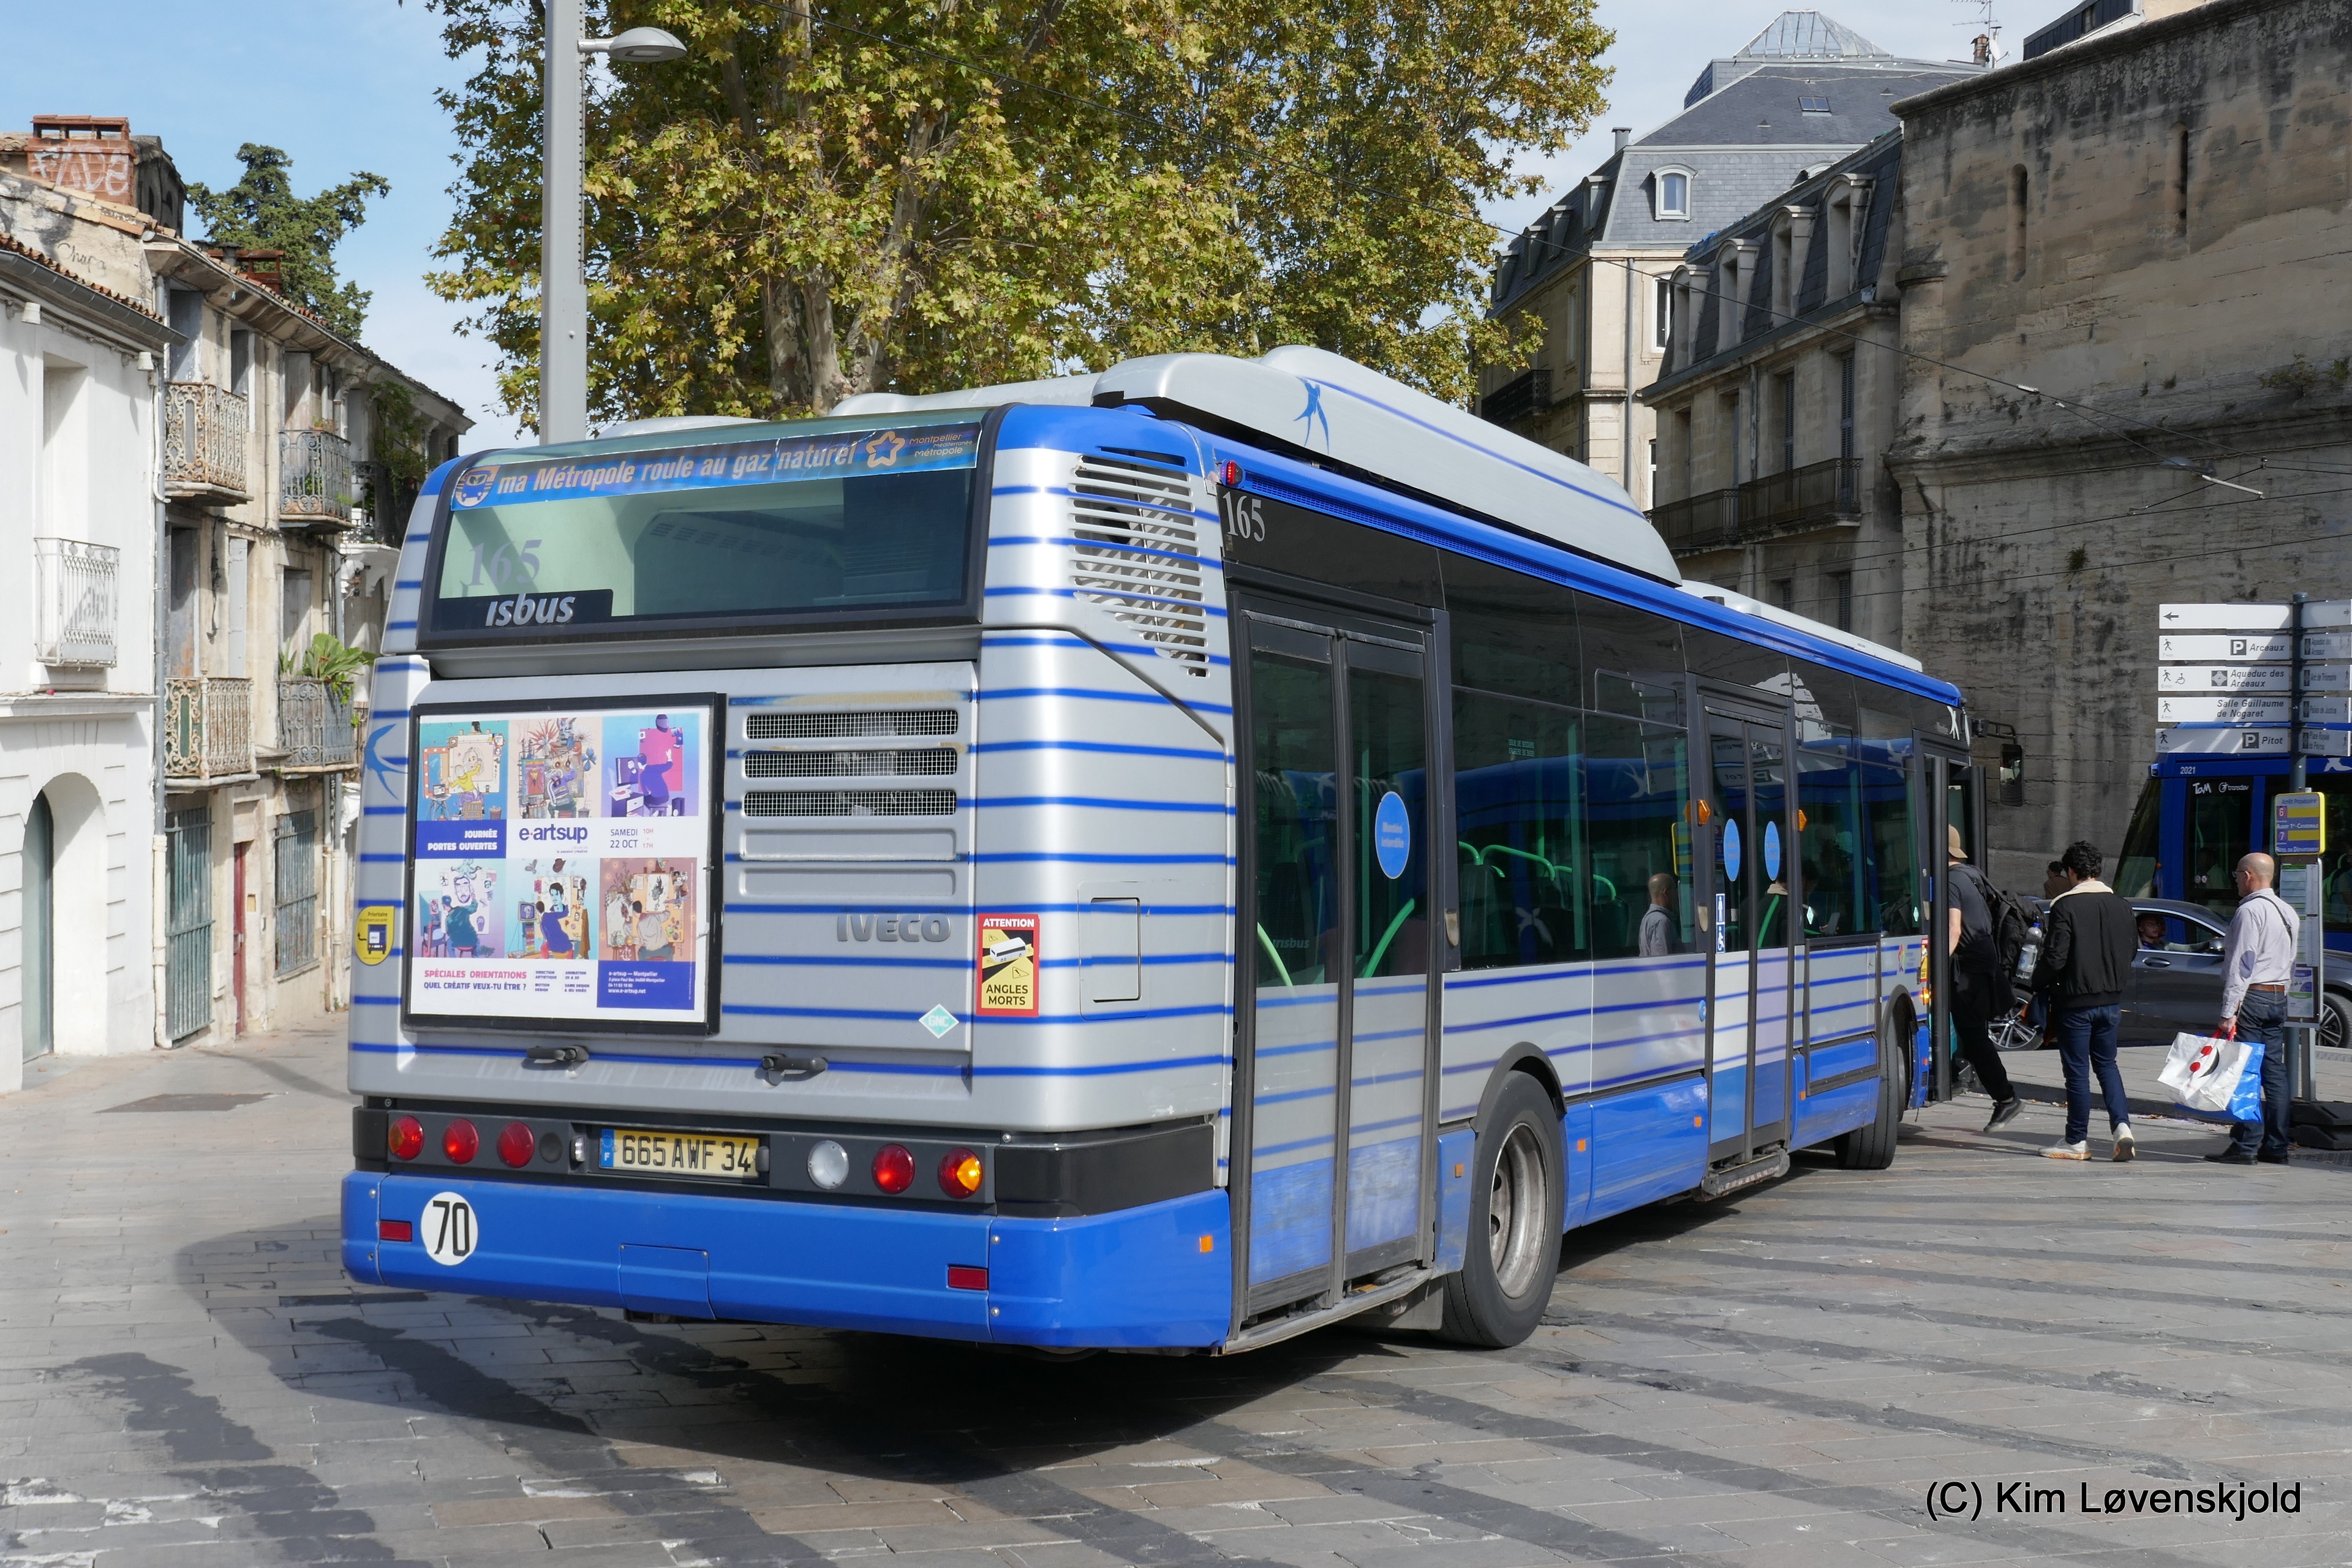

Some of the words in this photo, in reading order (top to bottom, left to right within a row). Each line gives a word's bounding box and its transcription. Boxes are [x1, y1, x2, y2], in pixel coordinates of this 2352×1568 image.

[497, 473, 527, 494] ma
[533, 461, 635, 492] Métropole
[641, 456, 698, 481] roule
[699, 456, 728, 477] au
[731, 453, 772, 480] gaz
[777, 440, 856, 471] naturel
[1223, 491, 1265, 542] 165
[467, 539, 542, 586] 165
[2230, 669, 2266, 679] Aqueduc
[2230, 709, 2264, 719] Nogaret
[2193, 782, 2212, 794] TaM
[2279, 808, 2284, 816] 6
[464, 829, 497, 839] JOURNÉE
[2280, 832, 2285, 840] 7
[610, 840, 619, 848] 22
[622, 840, 638, 848] OCT
[837, 913, 951, 943] IVECO
[983, 919, 1035, 928] ATTENTION
[424, 968, 466, 978] SPÉCIALES
[470, 971, 527, 979] ORIENTATIONS
[443, 981, 470, 989] CRÉATIF
[504, 982, 521, 990] ÊTRE
[986, 984, 1028, 994] ANGLES
[989, 996, 1026, 1006] MORTS
[928, 1016, 949, 1027] GNC
[604, 1153, 610, 1161] F
[622, 1135, 666, 1167] 665
[672, 1137, 716, 1170] AWF
[721, 1141, 751, 1172] 34
[432, 1200, 470, 1257] 70
